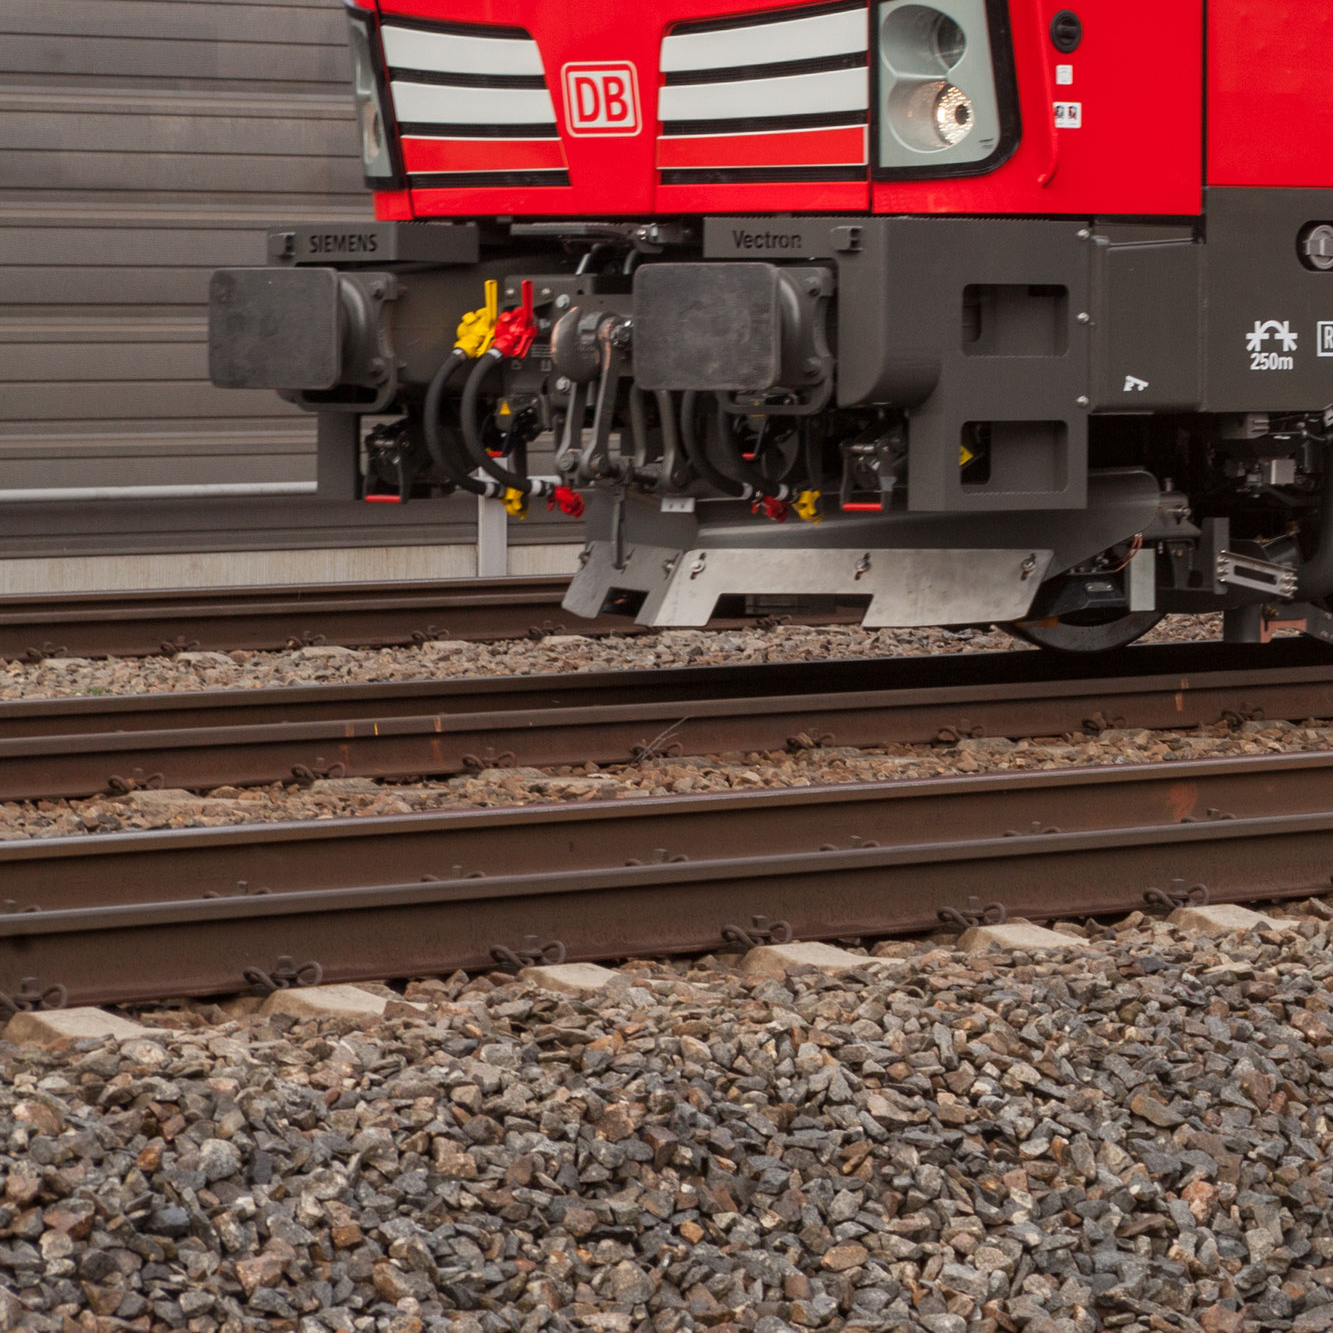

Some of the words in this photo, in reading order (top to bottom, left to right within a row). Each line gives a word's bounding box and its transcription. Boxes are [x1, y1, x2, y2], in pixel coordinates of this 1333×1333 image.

[574, 75, 630, 123] DB
[309, 234, 378, 254] SIEMENS
[732, 230, 803, 250] Vectron
[1324, 326, 1333, 349] R
[1250, 352, 1294, 370] 250m
